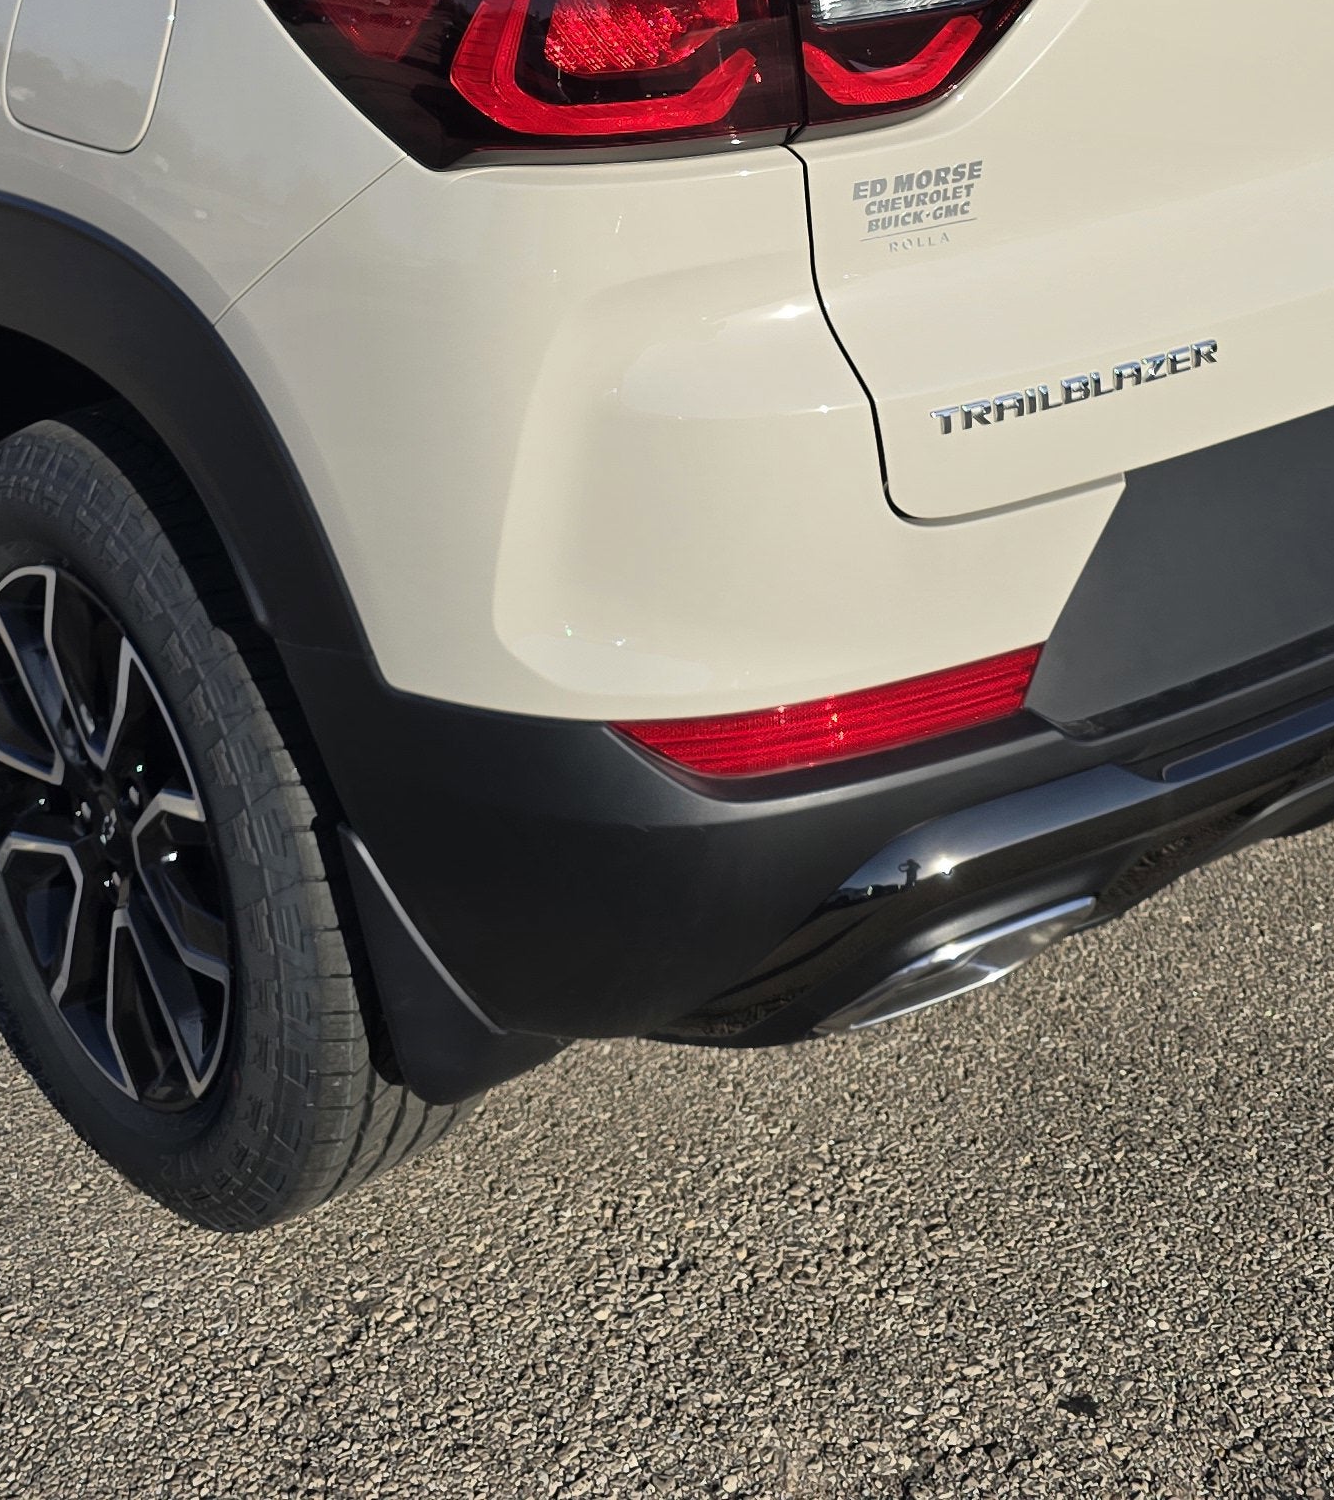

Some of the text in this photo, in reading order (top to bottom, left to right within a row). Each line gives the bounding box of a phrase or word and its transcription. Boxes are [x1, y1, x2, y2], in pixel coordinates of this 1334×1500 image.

[853, 160, 983, 200] ED MORSE
[865, 183, 974, 216] CHEVROLET
[889, 232, 950, 253] ROLLA
[930, 339, 1217, 435] TRAILBLAZER
